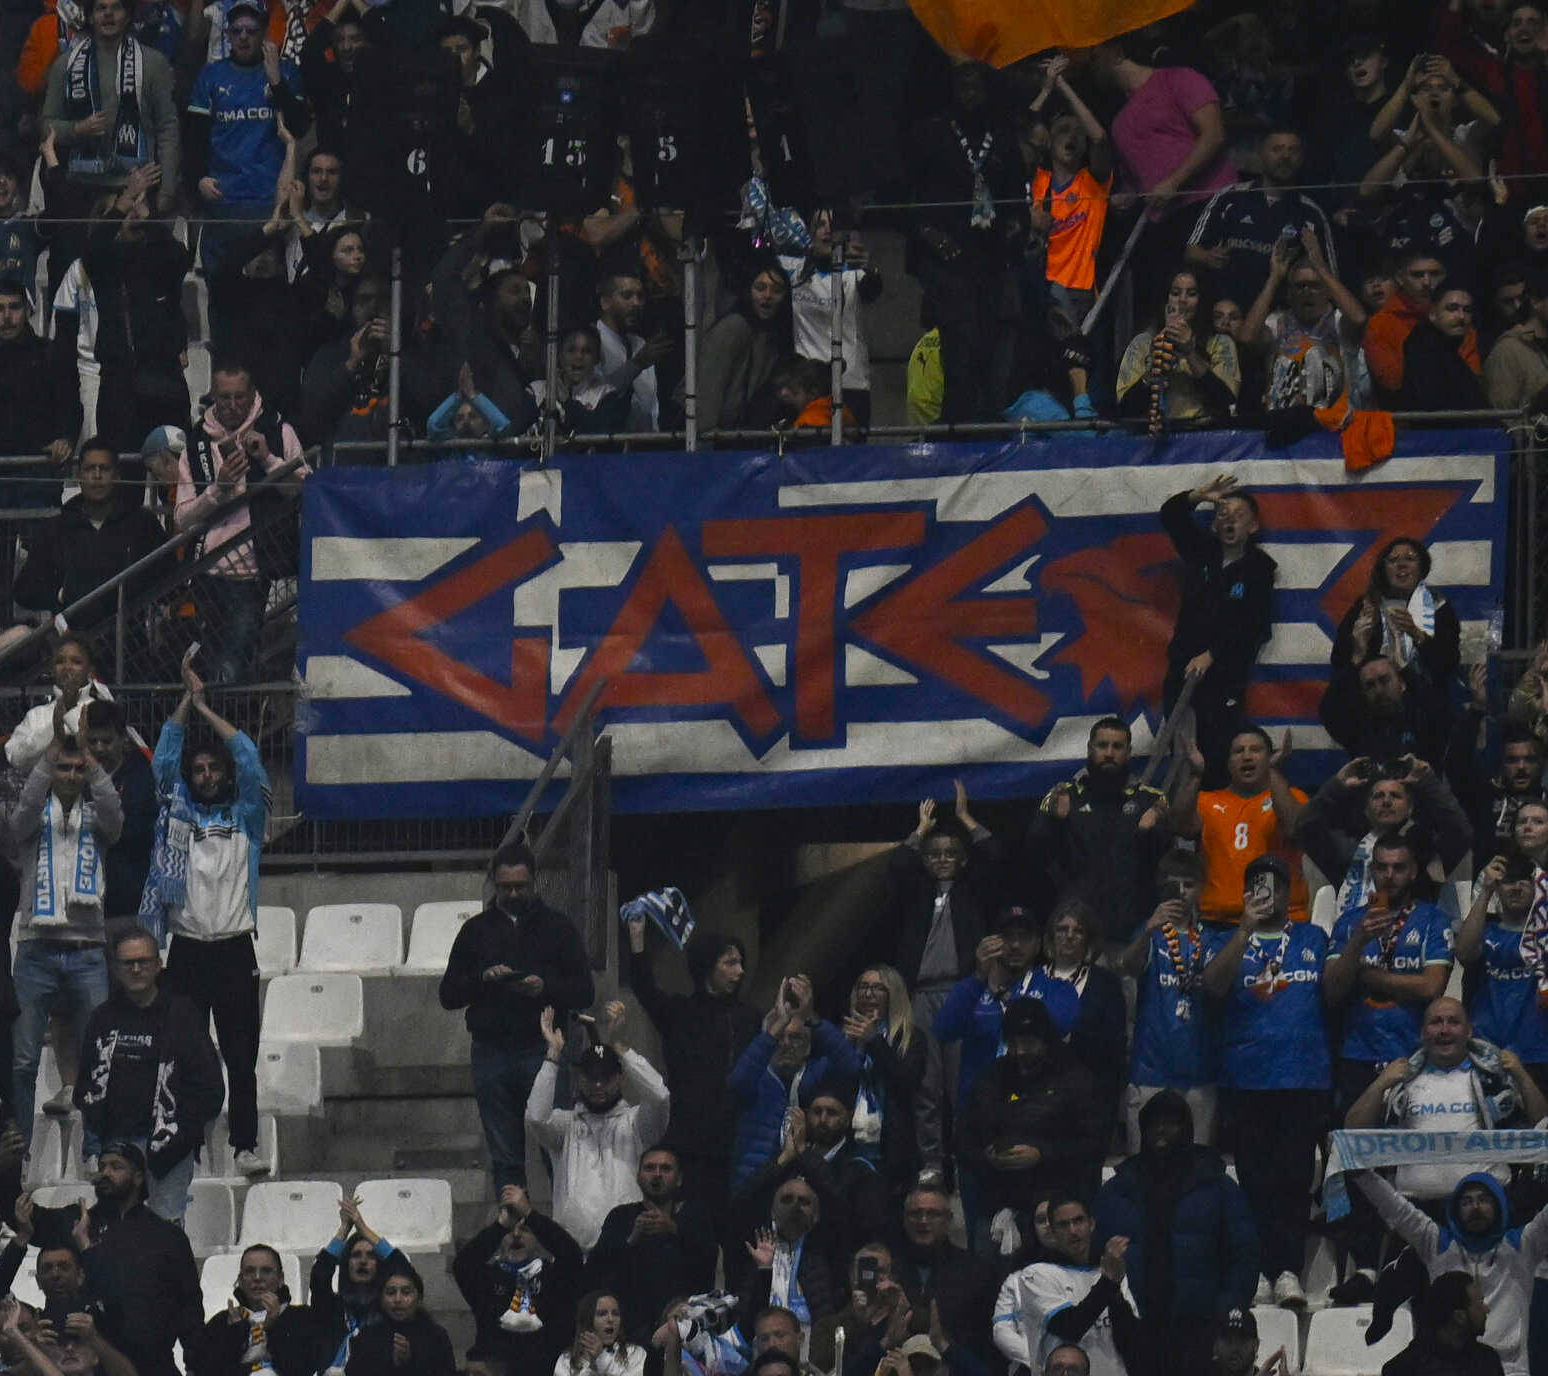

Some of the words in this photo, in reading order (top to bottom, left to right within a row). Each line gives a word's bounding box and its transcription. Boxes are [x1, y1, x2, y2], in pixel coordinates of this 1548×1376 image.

[1233, 821, 1250, 851] 8
[1449, 1103, 1475, 1116] CG
[1353, 1130, 1461, 1157] DROIT
